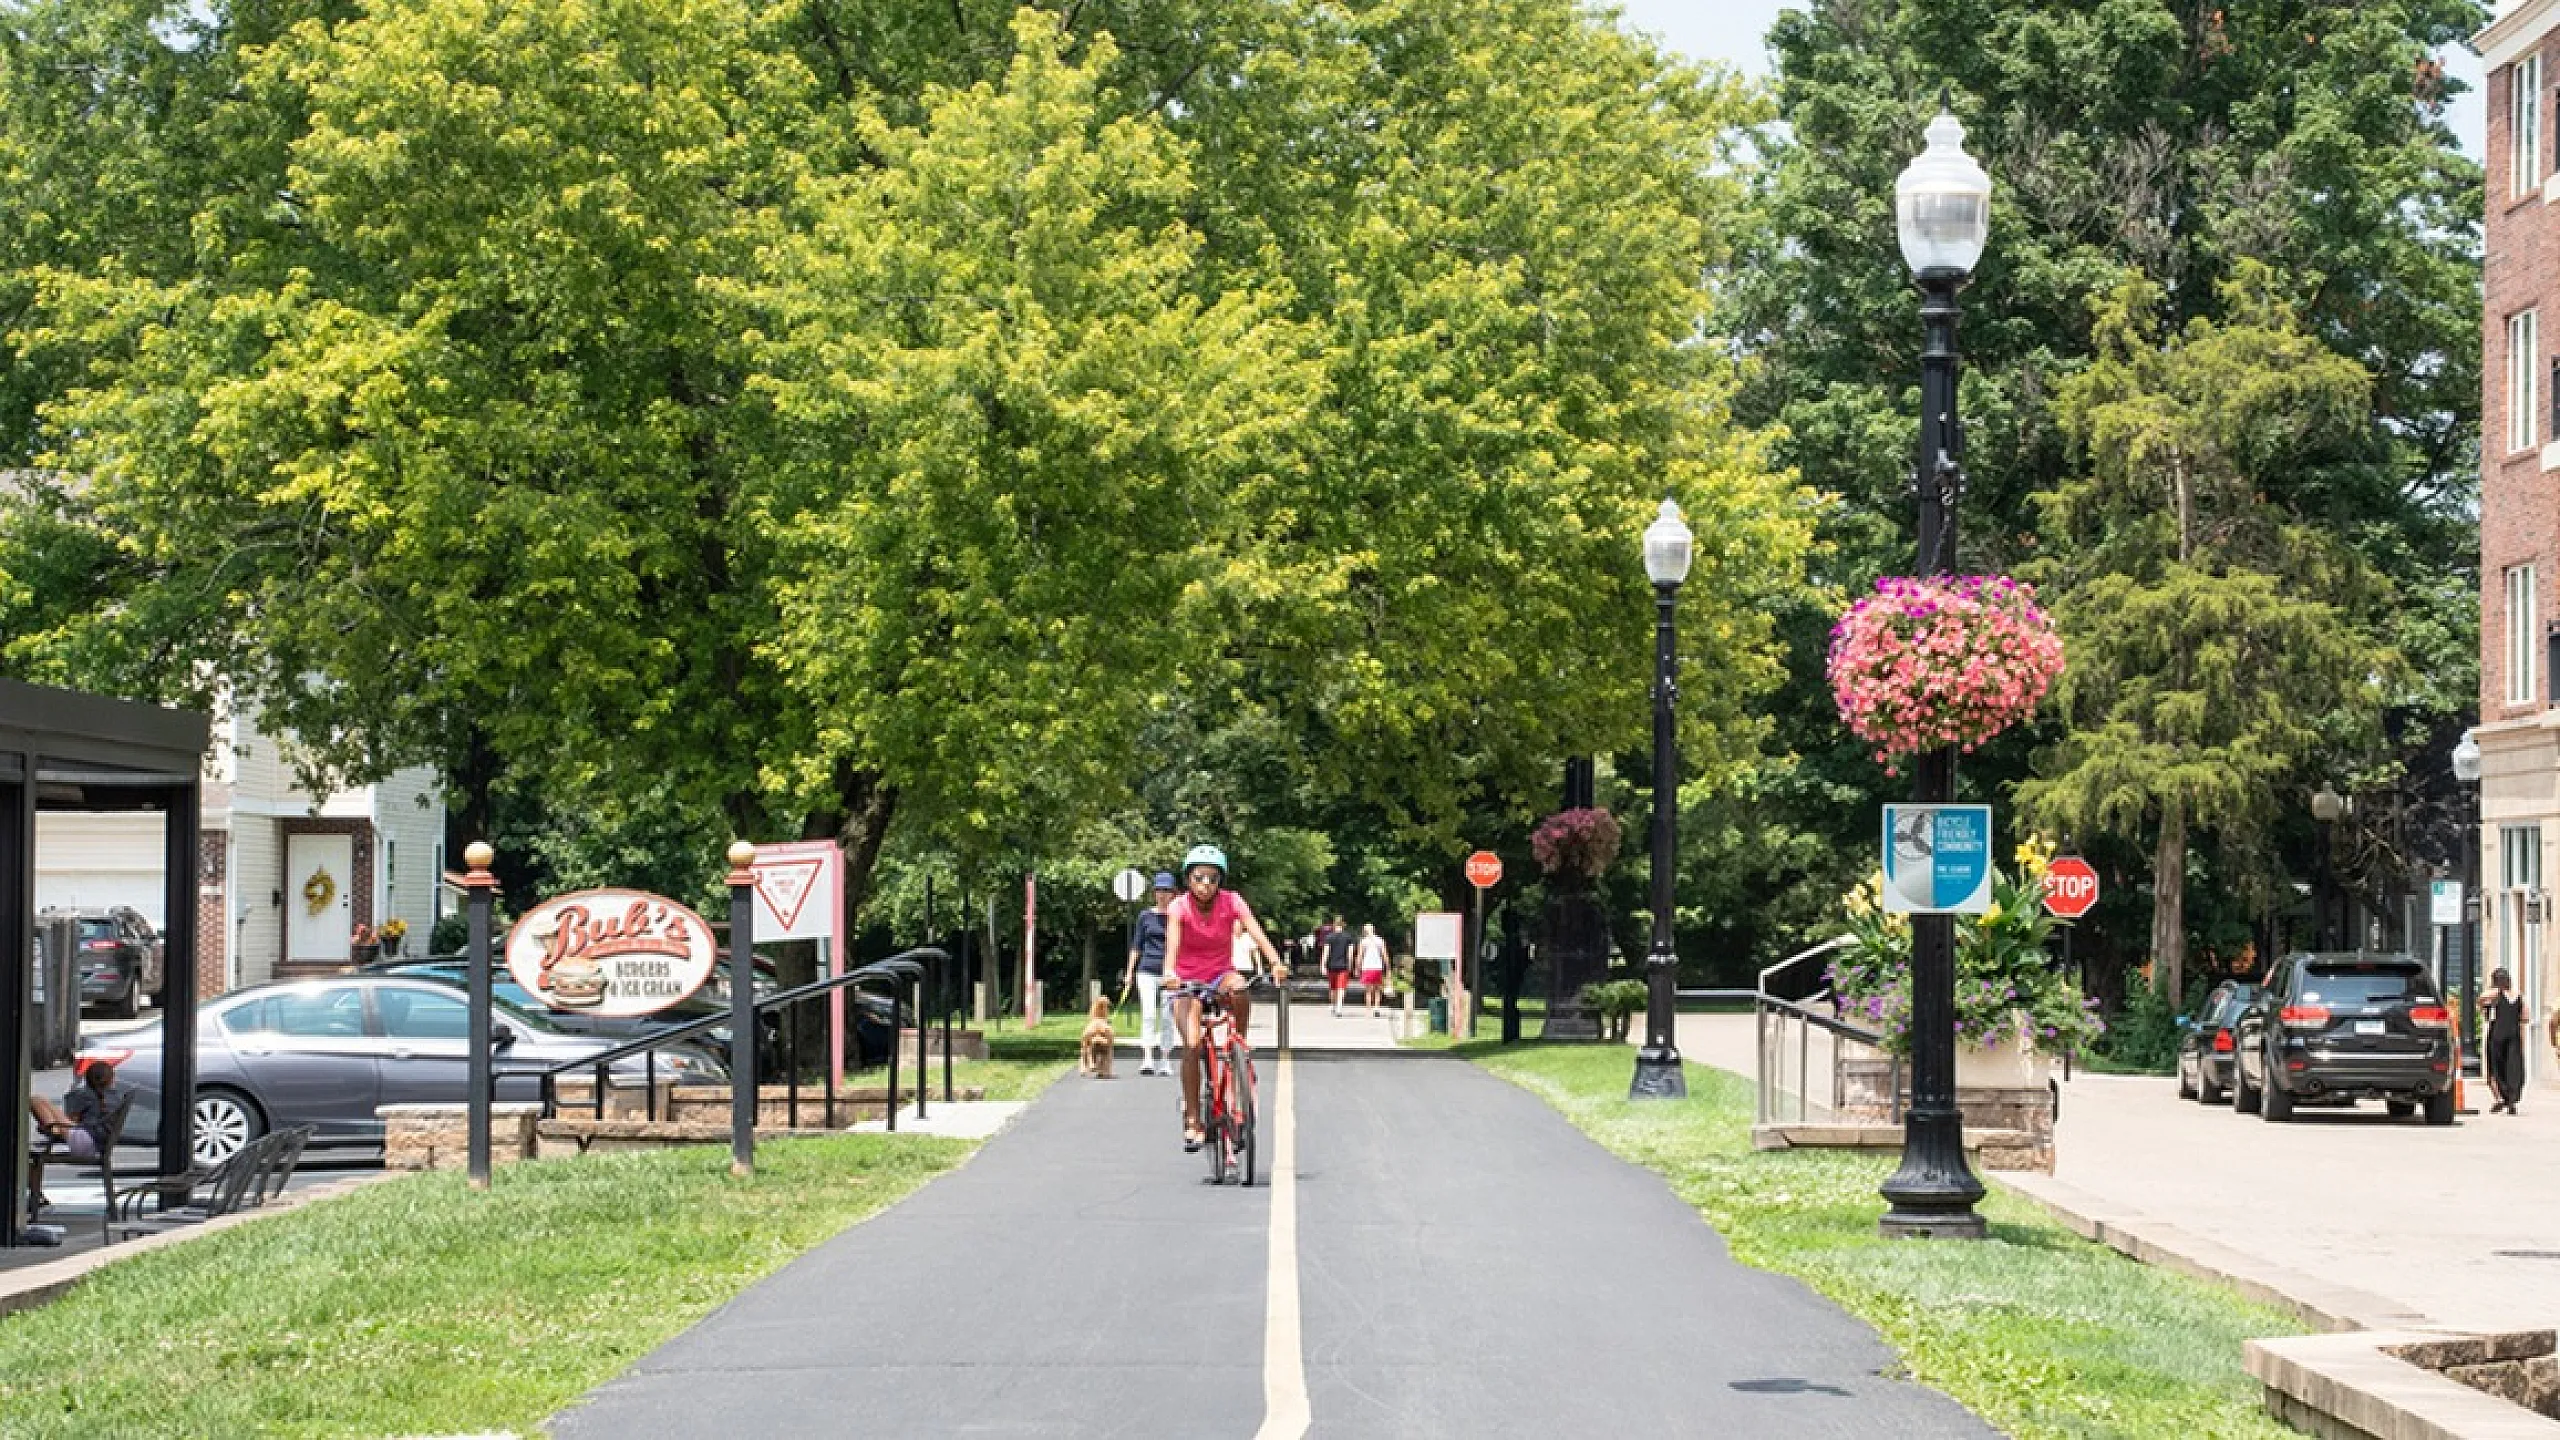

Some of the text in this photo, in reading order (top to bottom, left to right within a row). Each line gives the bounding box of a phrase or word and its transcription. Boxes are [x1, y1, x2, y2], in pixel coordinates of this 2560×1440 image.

[1467, 863, 1500, 876] STOP
[2044, 876, 2093, 898] STOP
[540, 901, 690, 972] Bub's
[615, 960, 671, 978] BURGERS
[620, 980, 640, 997] ICE
[643, 980, 683, 997] CREAM
